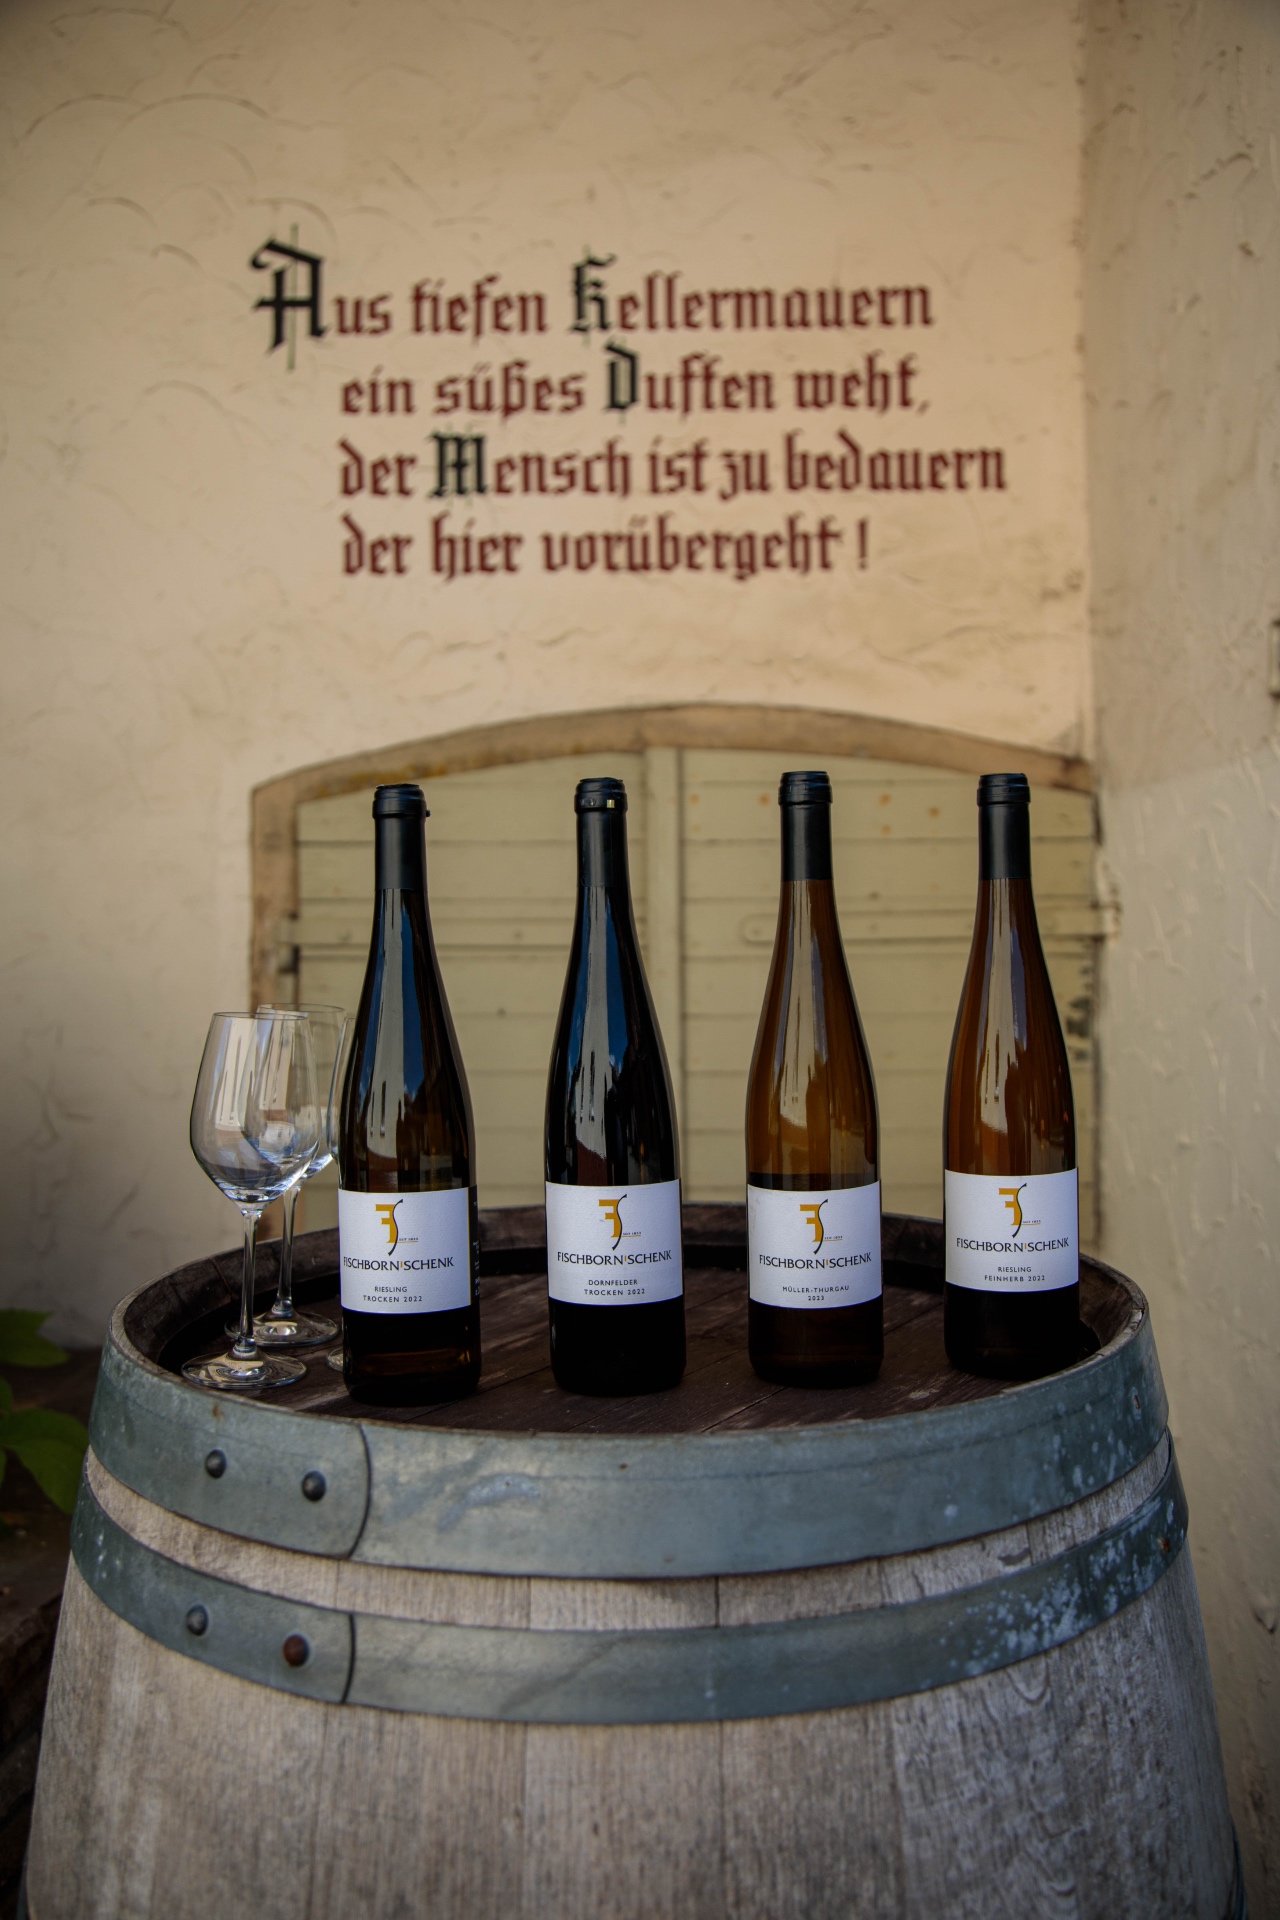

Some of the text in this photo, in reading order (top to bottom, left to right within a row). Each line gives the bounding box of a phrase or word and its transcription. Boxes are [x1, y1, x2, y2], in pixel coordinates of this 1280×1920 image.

[249, 234, 935, 360] Aus tiefen Kellermauern
[340, 342, 931, 422] ein süßes Duften weht,
[337, 427, 1008, 502] der Mensch ist zu bedauern
[339, 510, 414, 576] der
[431, 509, 524, 583] hier
[540, 511, 843, 583] vorübergeht
[783, 1285, 849, 1293] MÜLLER-THURGAU
